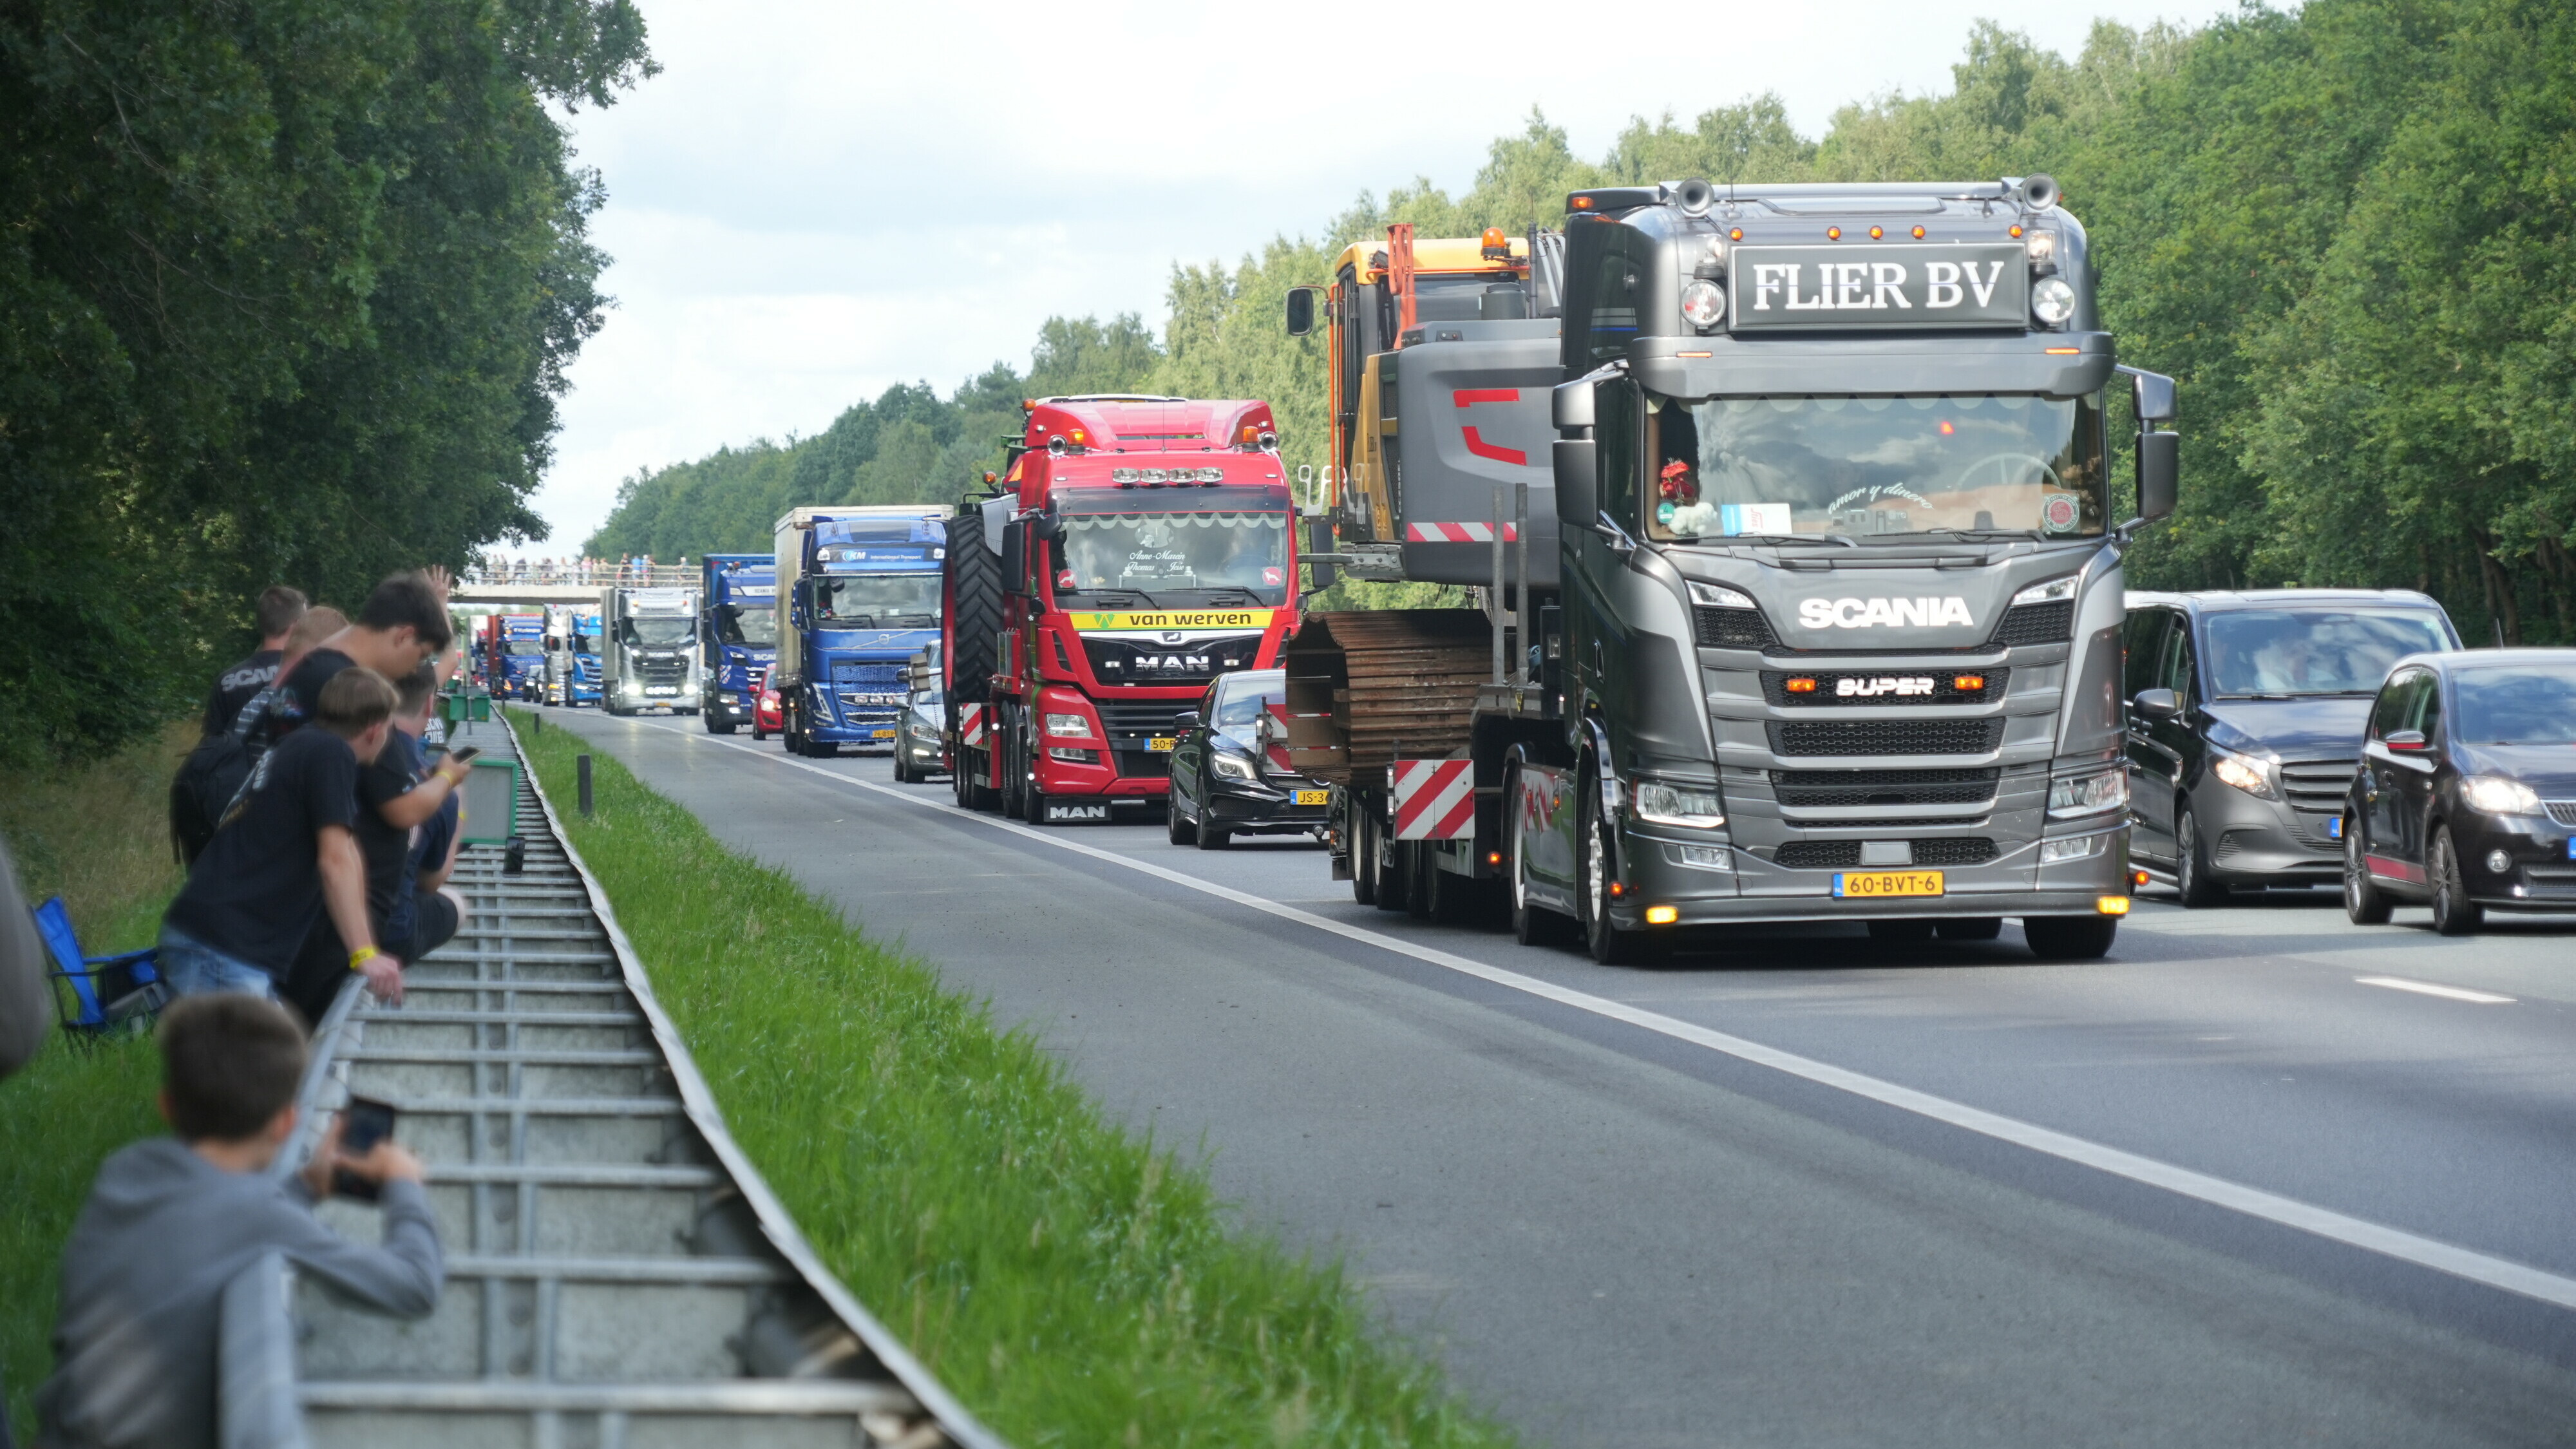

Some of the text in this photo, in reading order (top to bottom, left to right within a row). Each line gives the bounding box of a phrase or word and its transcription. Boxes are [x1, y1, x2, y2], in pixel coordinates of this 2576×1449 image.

[1753, 261, 2004, 310] FLIER BV
[1828, 482, 1935, 515] amor y dinero
[1127, 562, 1155, 571] Thomas
[1130, 613, 1251, 625] van werven
[1799, 598, 1974, 629] SCANIA
[1135, 656, 1209, 672] MAN
[1837, 677, 1935, 696] SUPER
[1050, 806, 1105, 819] MAN
[1850, 875, 1936, 893] 60-BVT-6
